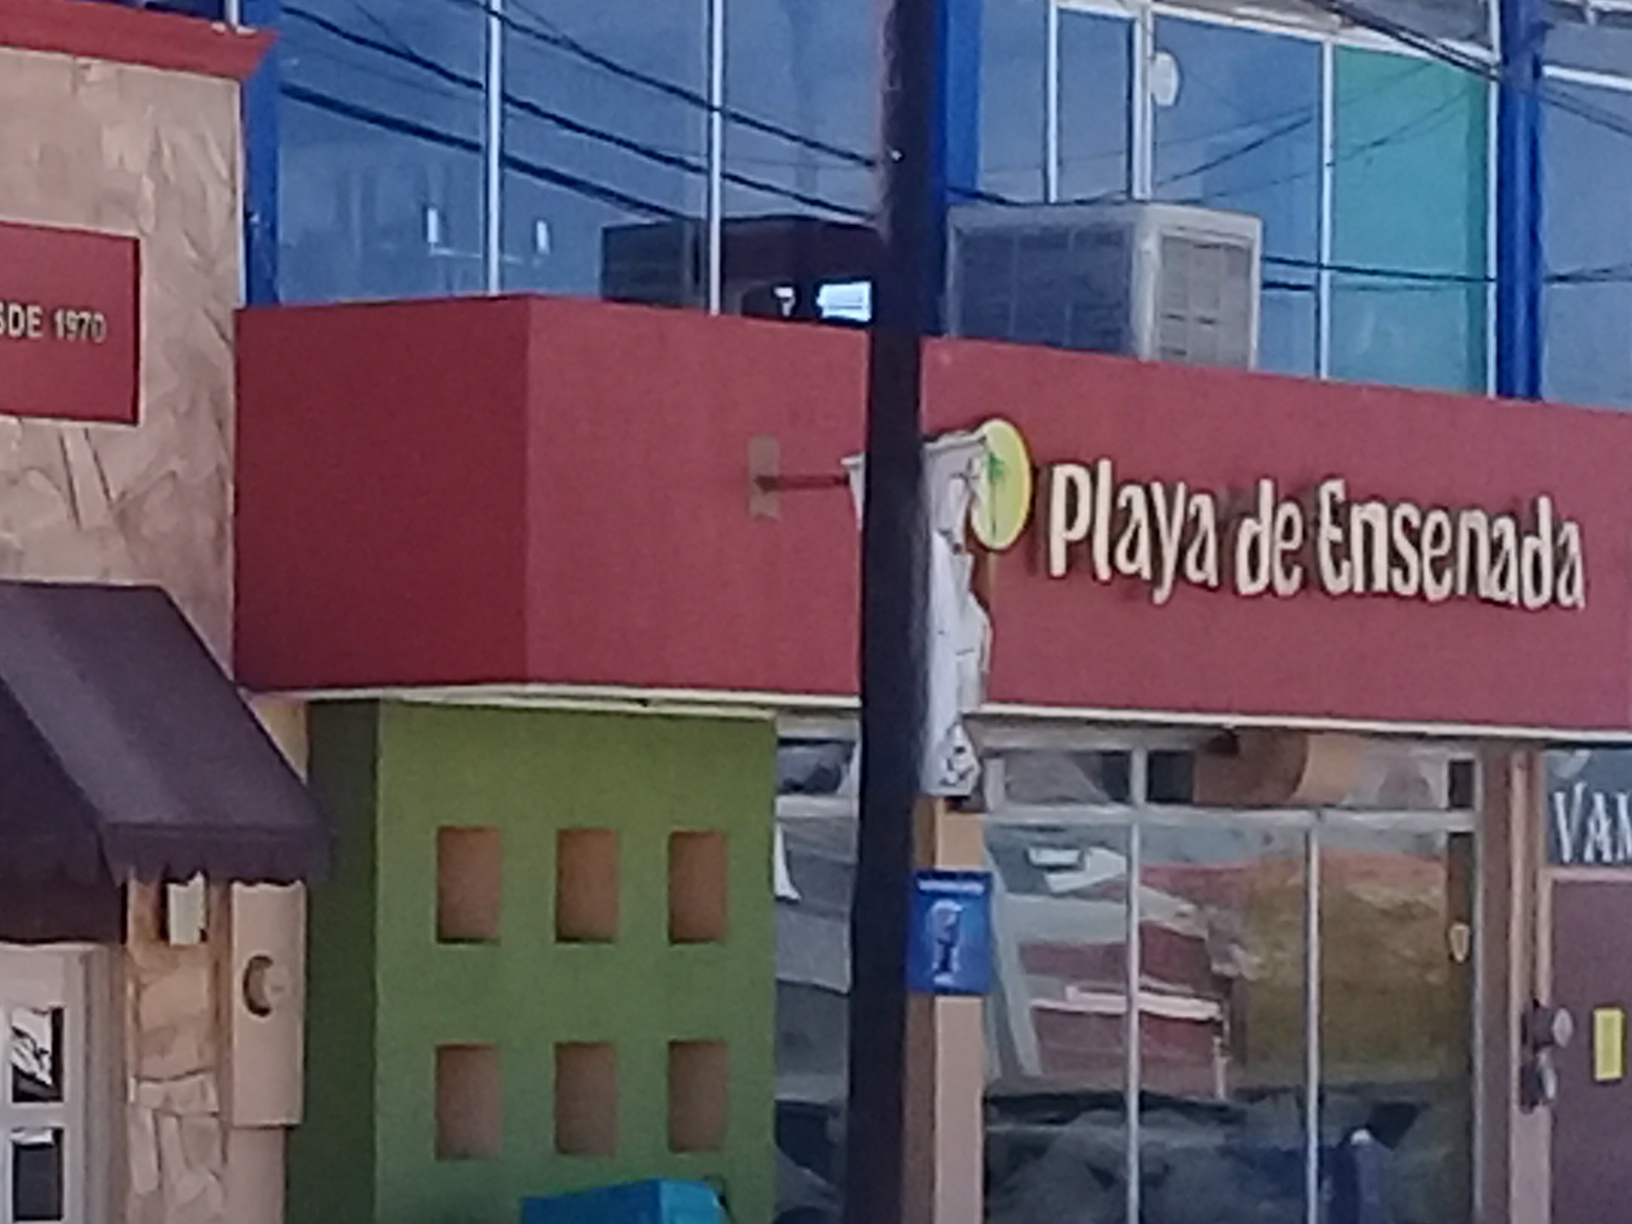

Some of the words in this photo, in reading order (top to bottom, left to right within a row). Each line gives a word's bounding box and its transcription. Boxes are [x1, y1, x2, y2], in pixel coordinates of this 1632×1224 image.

[54, 308, 107, 344] 1970
[1049, 457, 1218, 605] Playa
[1236, 478, 1304, 597] de
[1318, 477, 1585, 611] Ensenada
